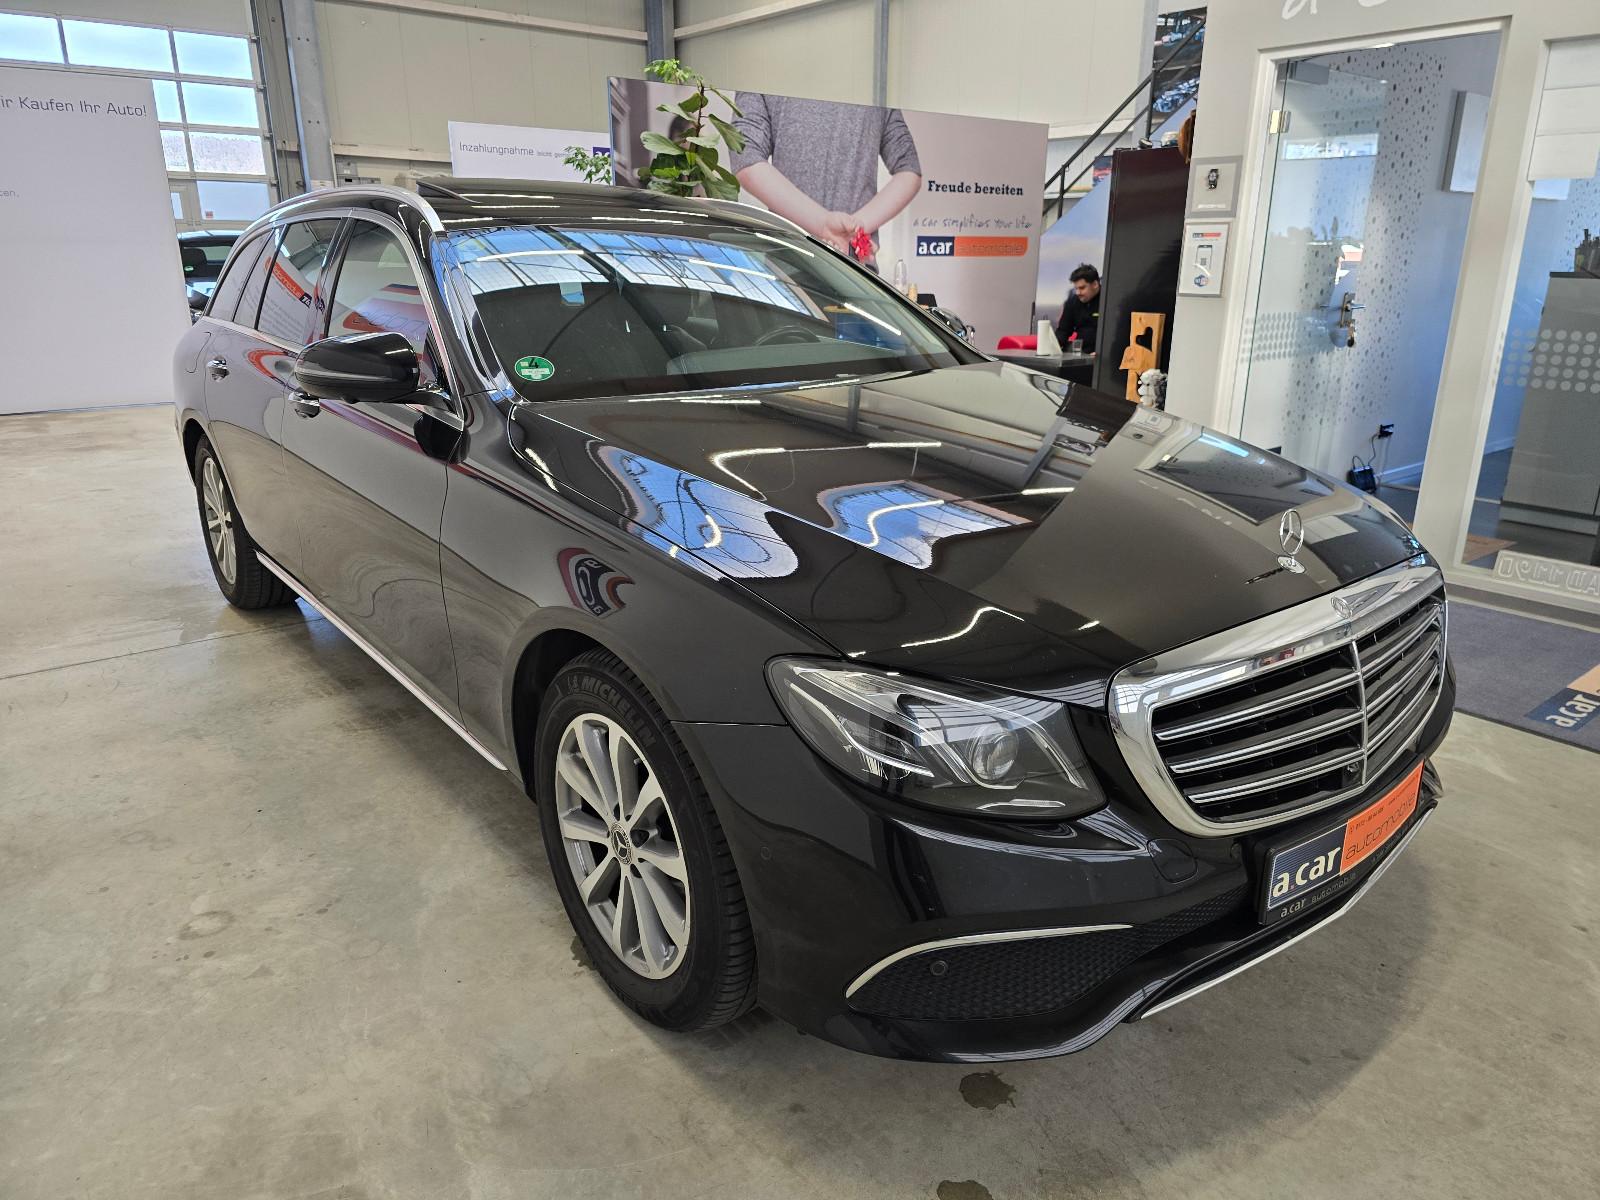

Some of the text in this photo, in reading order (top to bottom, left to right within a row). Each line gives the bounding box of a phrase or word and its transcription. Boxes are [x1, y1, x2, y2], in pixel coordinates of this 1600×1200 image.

[0, 95, 147, 117] ir Kaufen Ihr Auto!
[459, 141, 534, 156] Inzahlungnahme
[927, 180, 1024, 196] Freude bereiten
[581, 675, 657, 748] MICHELIN
[1345, 792, 1416, 860] automobile
